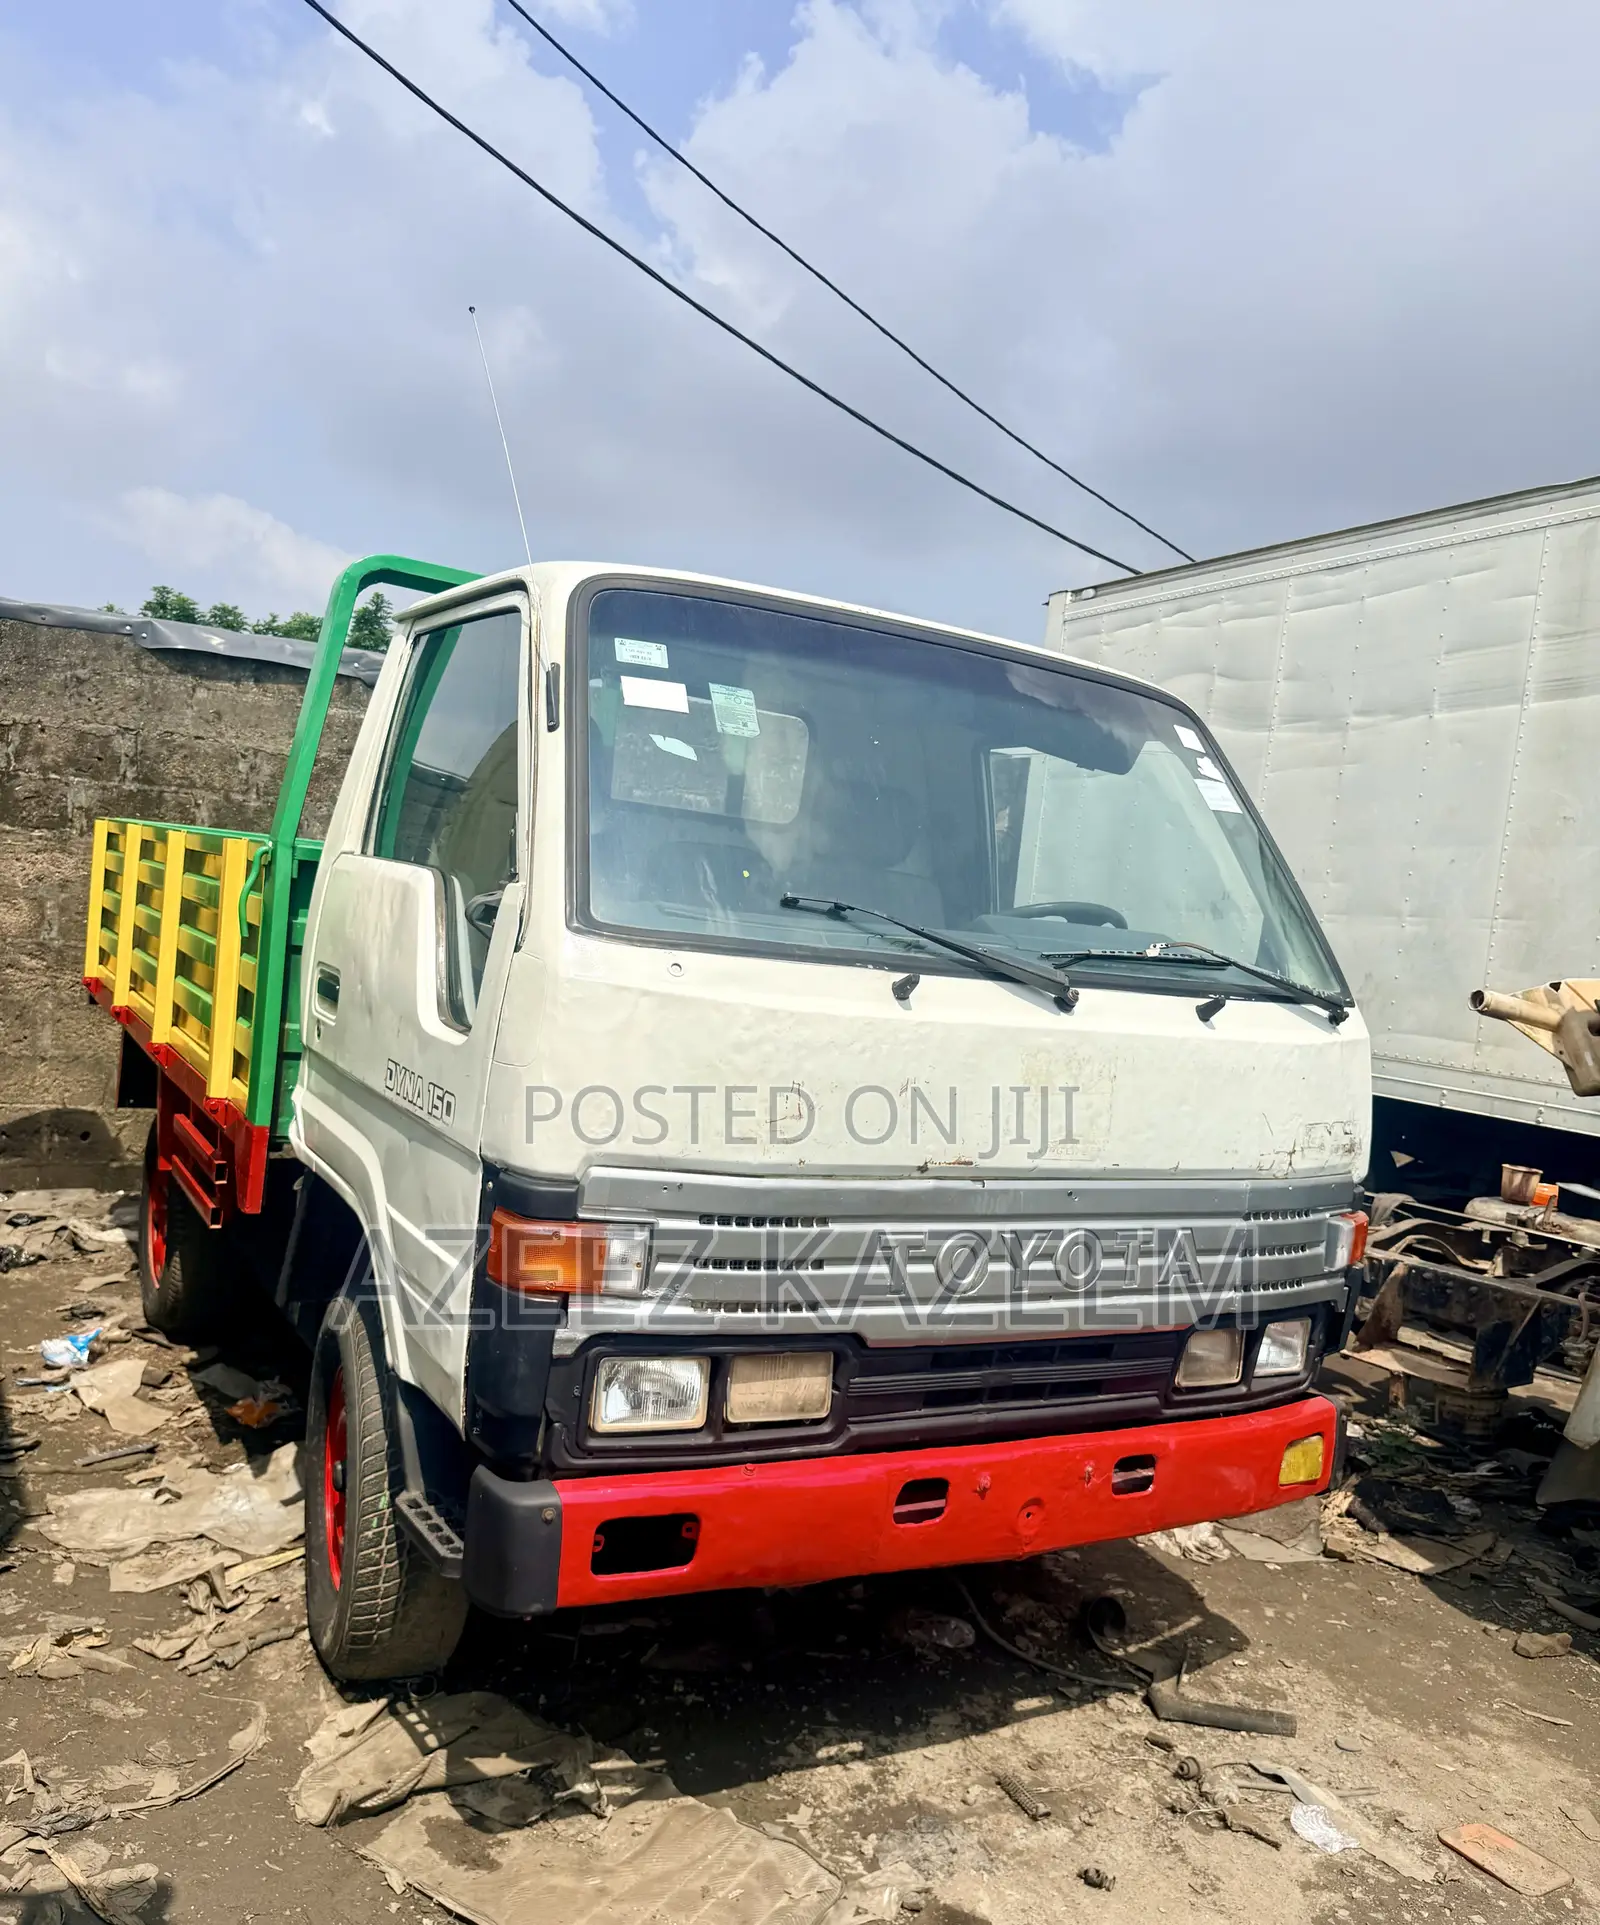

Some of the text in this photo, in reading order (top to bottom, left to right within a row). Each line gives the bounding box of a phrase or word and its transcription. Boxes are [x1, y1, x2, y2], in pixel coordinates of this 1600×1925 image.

[385, 1058, 456, 1126] DYNA 150
[877, 1227, 1204, 1296] TOYOTA
